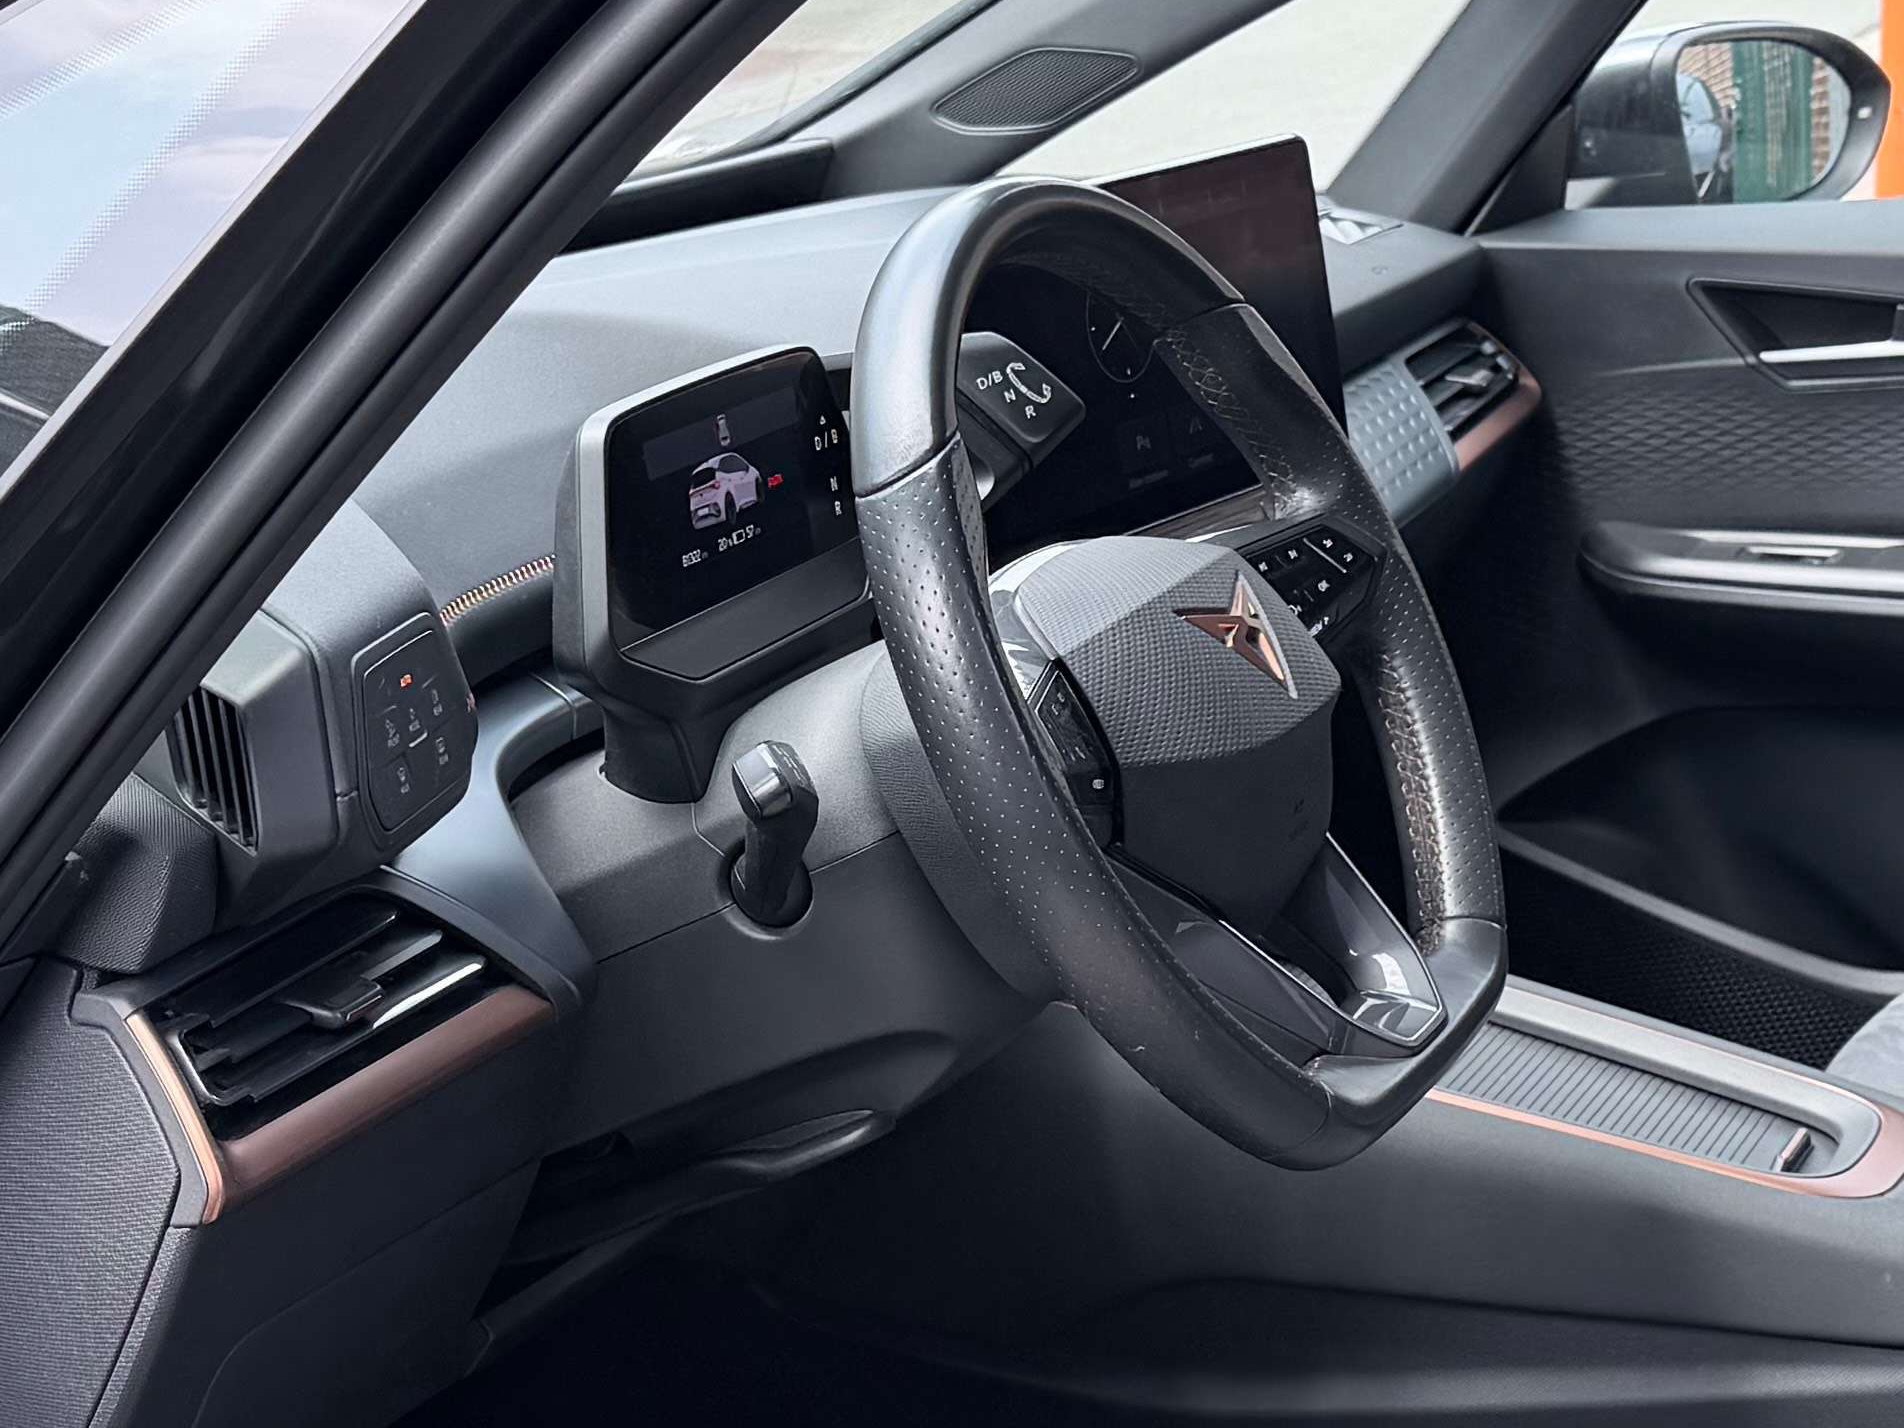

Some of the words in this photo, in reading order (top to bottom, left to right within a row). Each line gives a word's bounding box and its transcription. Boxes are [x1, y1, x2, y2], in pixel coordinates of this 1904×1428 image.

[976, 370, 1003, 390] D/B
[1003, 388, 1016, 403] N
[1024, 405, 1036, 419] R
